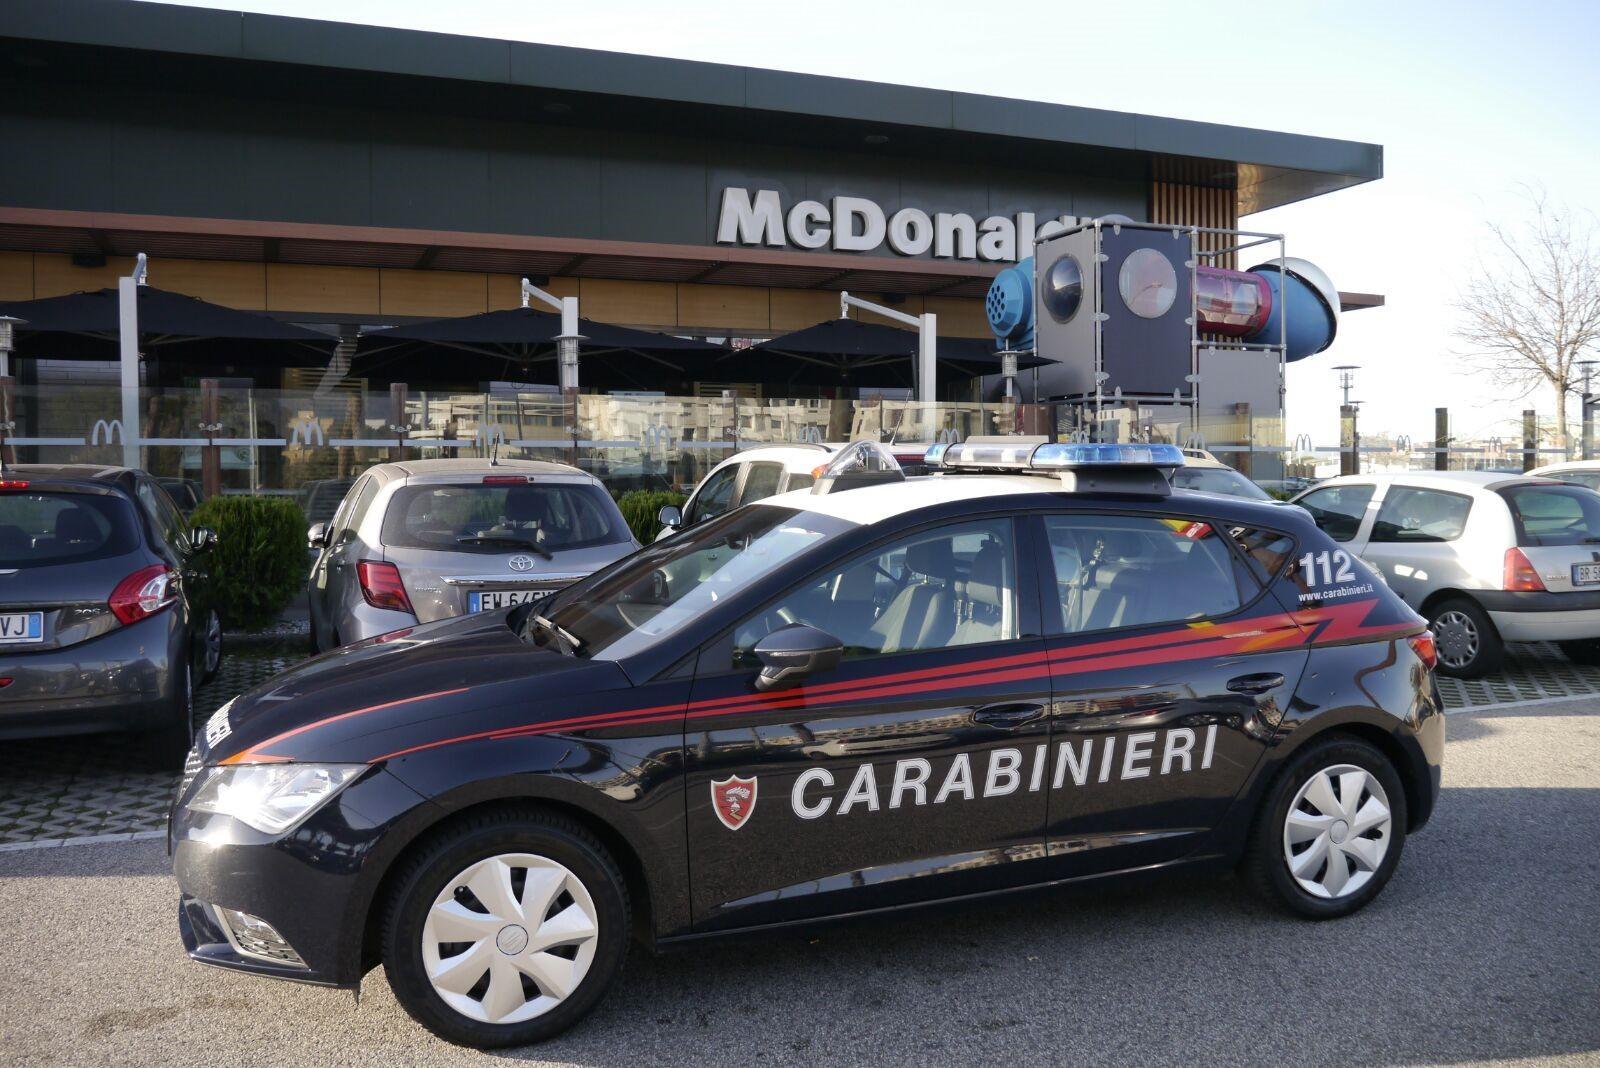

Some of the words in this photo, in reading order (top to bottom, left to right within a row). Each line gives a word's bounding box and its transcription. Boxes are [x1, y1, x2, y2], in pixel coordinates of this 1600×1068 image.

[716, 186, 1093, 263] McDonal
[1299, 548, 1356, 587] 112
[1298, 583, 1374, 602] www.carabinieri.it
[0, 616, 25, 636] VJ
[791, 725, 1219, 820] CARABINIERI
